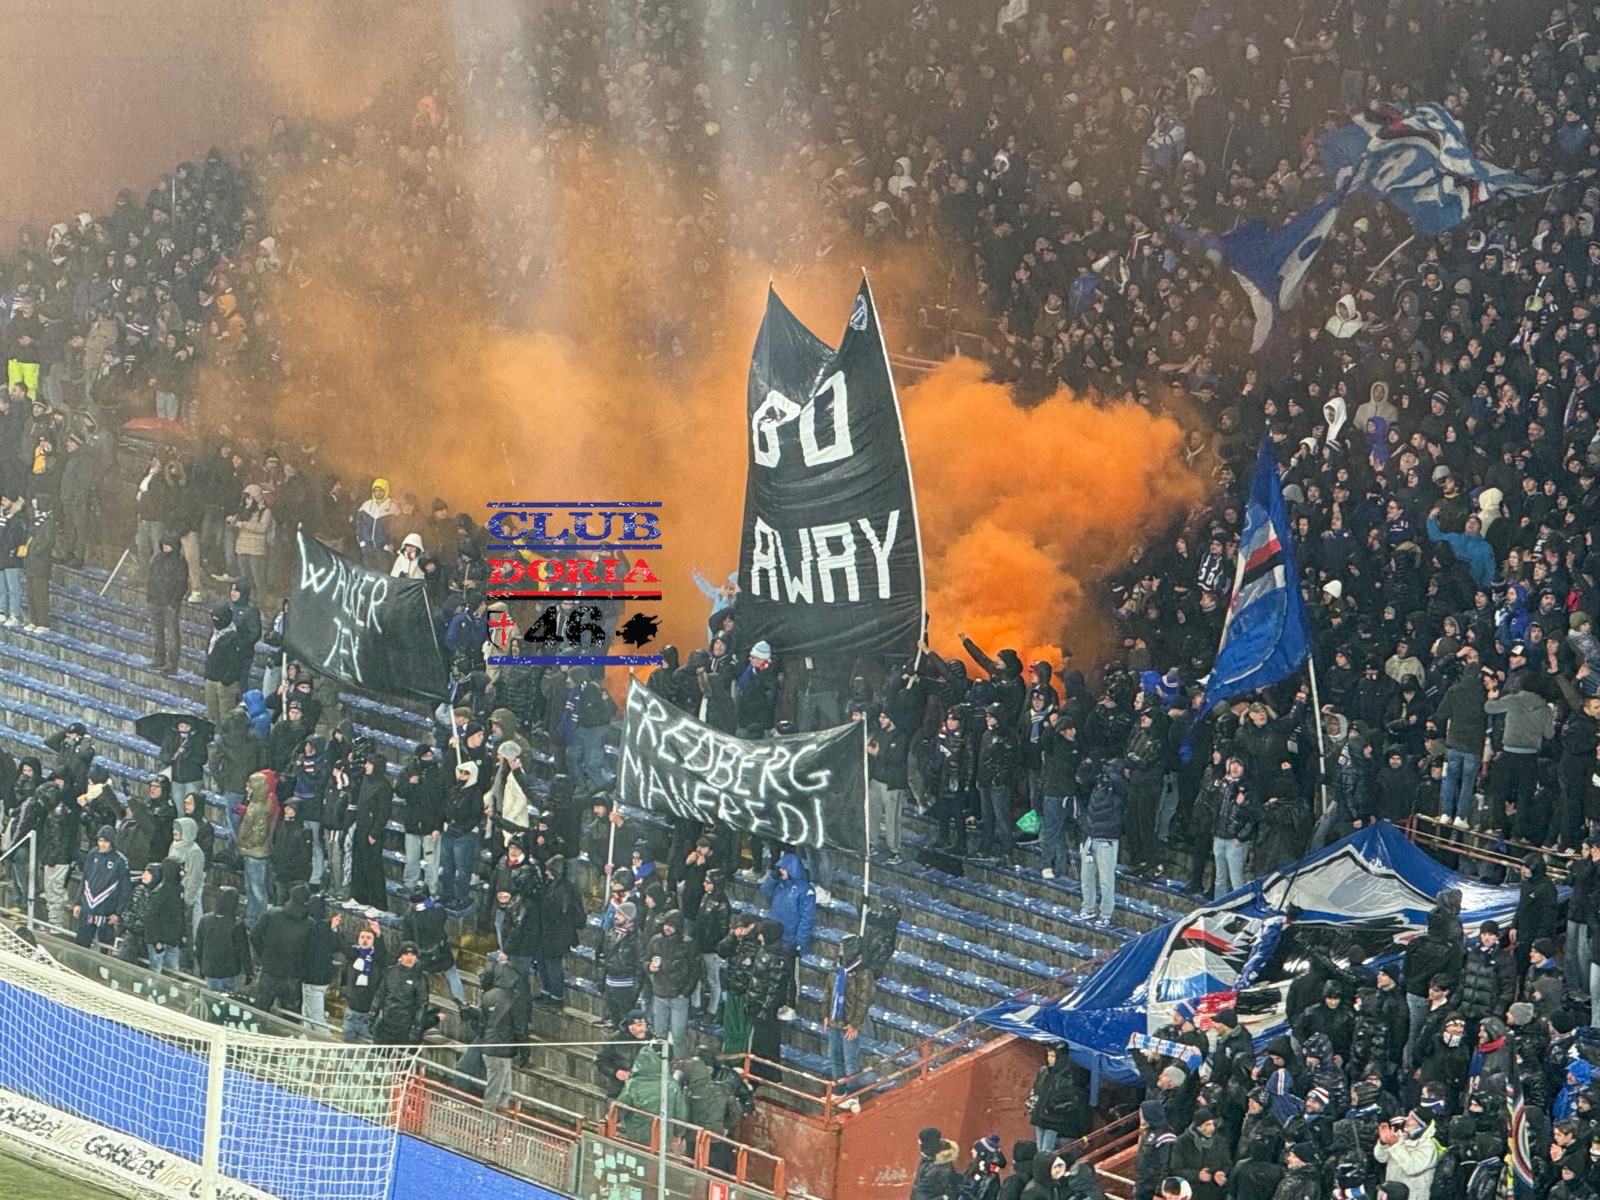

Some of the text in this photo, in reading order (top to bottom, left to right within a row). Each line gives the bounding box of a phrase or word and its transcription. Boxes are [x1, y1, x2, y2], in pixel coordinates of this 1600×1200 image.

[751, 509, 900, 604] AWAY
[626, 679, 832, 799] FREDBERG
[620, 744, 825, 849] MANFREDI
